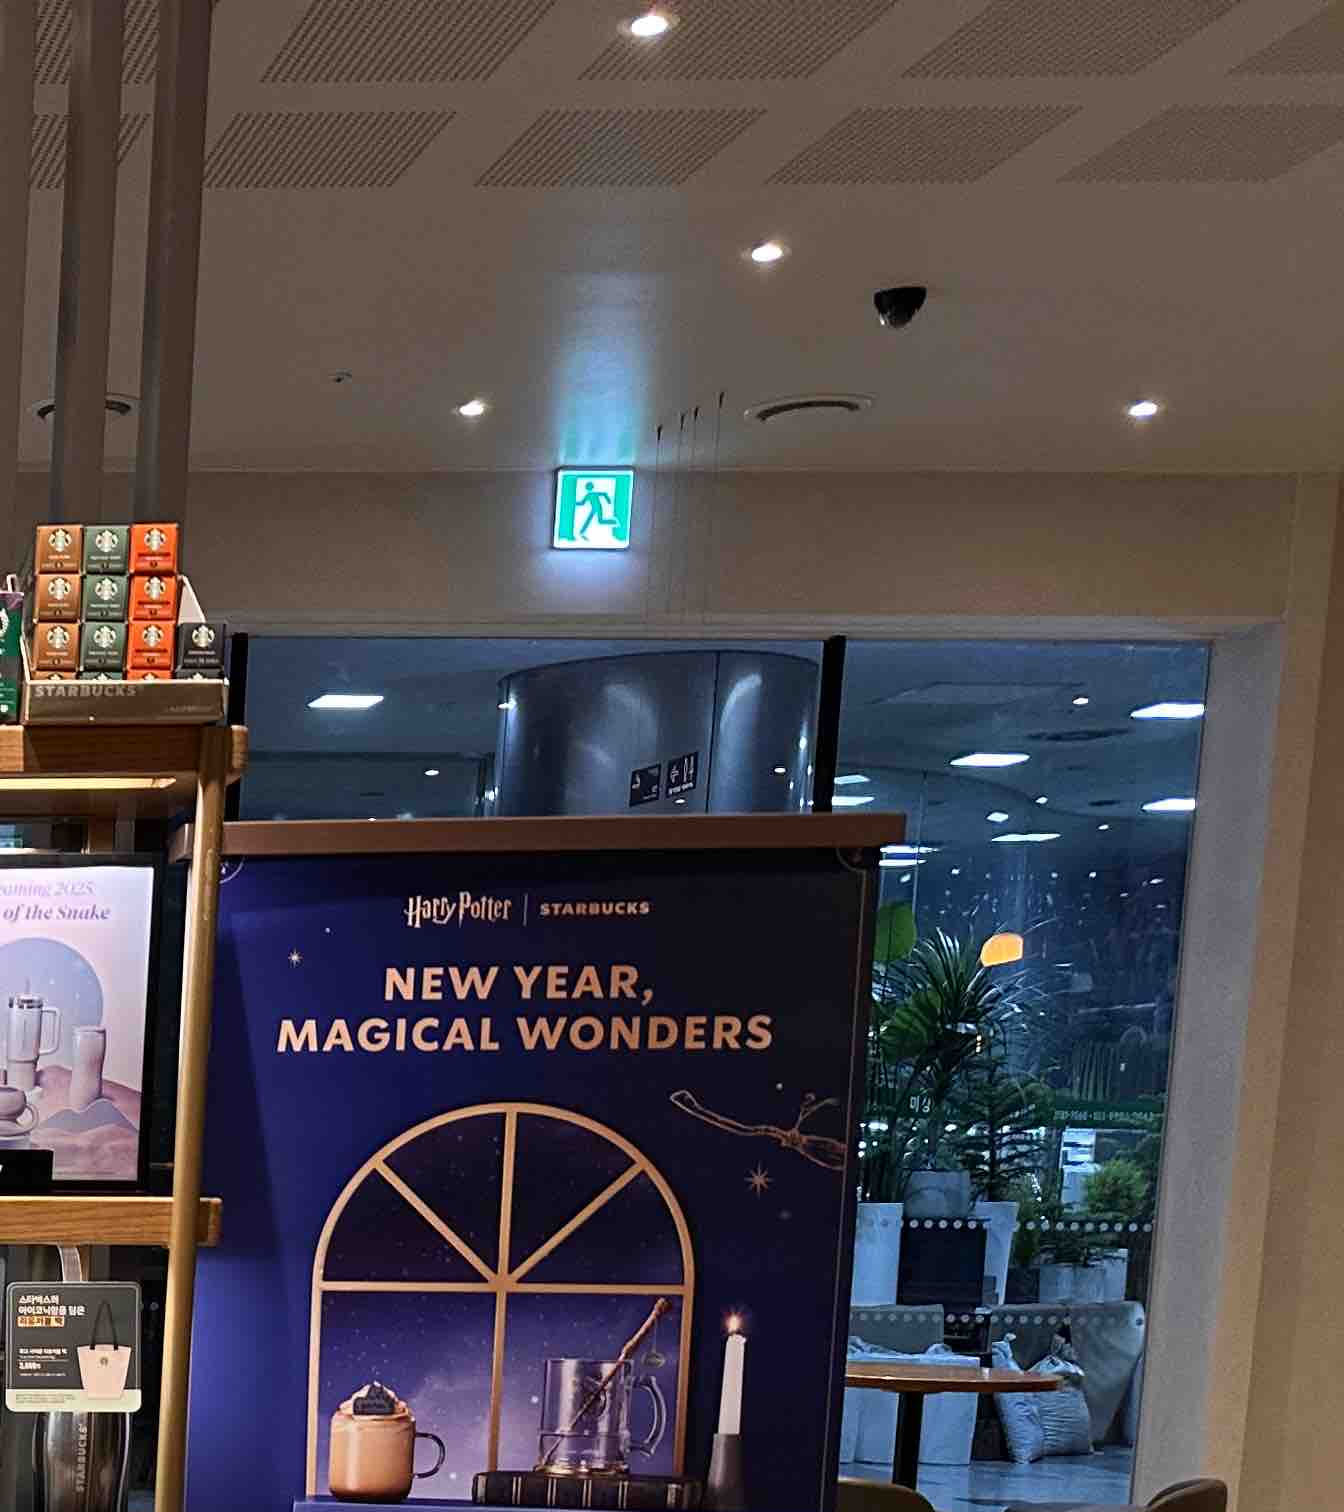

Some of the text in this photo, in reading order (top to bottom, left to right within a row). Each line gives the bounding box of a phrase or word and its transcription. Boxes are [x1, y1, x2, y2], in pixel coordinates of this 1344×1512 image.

[34, 685, 137, 698] STARBUCKS
[54, 881, 96, 897] 2025
[2, 903, 22, 923] of
[23, 904, 54, 921] the
[56, 904, 112, 921] Snake
[404, 890, 650, 929] Harry Potter STARBUCKS
[384, 964, 655, 1006] NEW YEAR,
[277, 1014, 774, 1053] MAGICAL WONDERS
[75, 1425, 88, 1494] STARBUCKS
